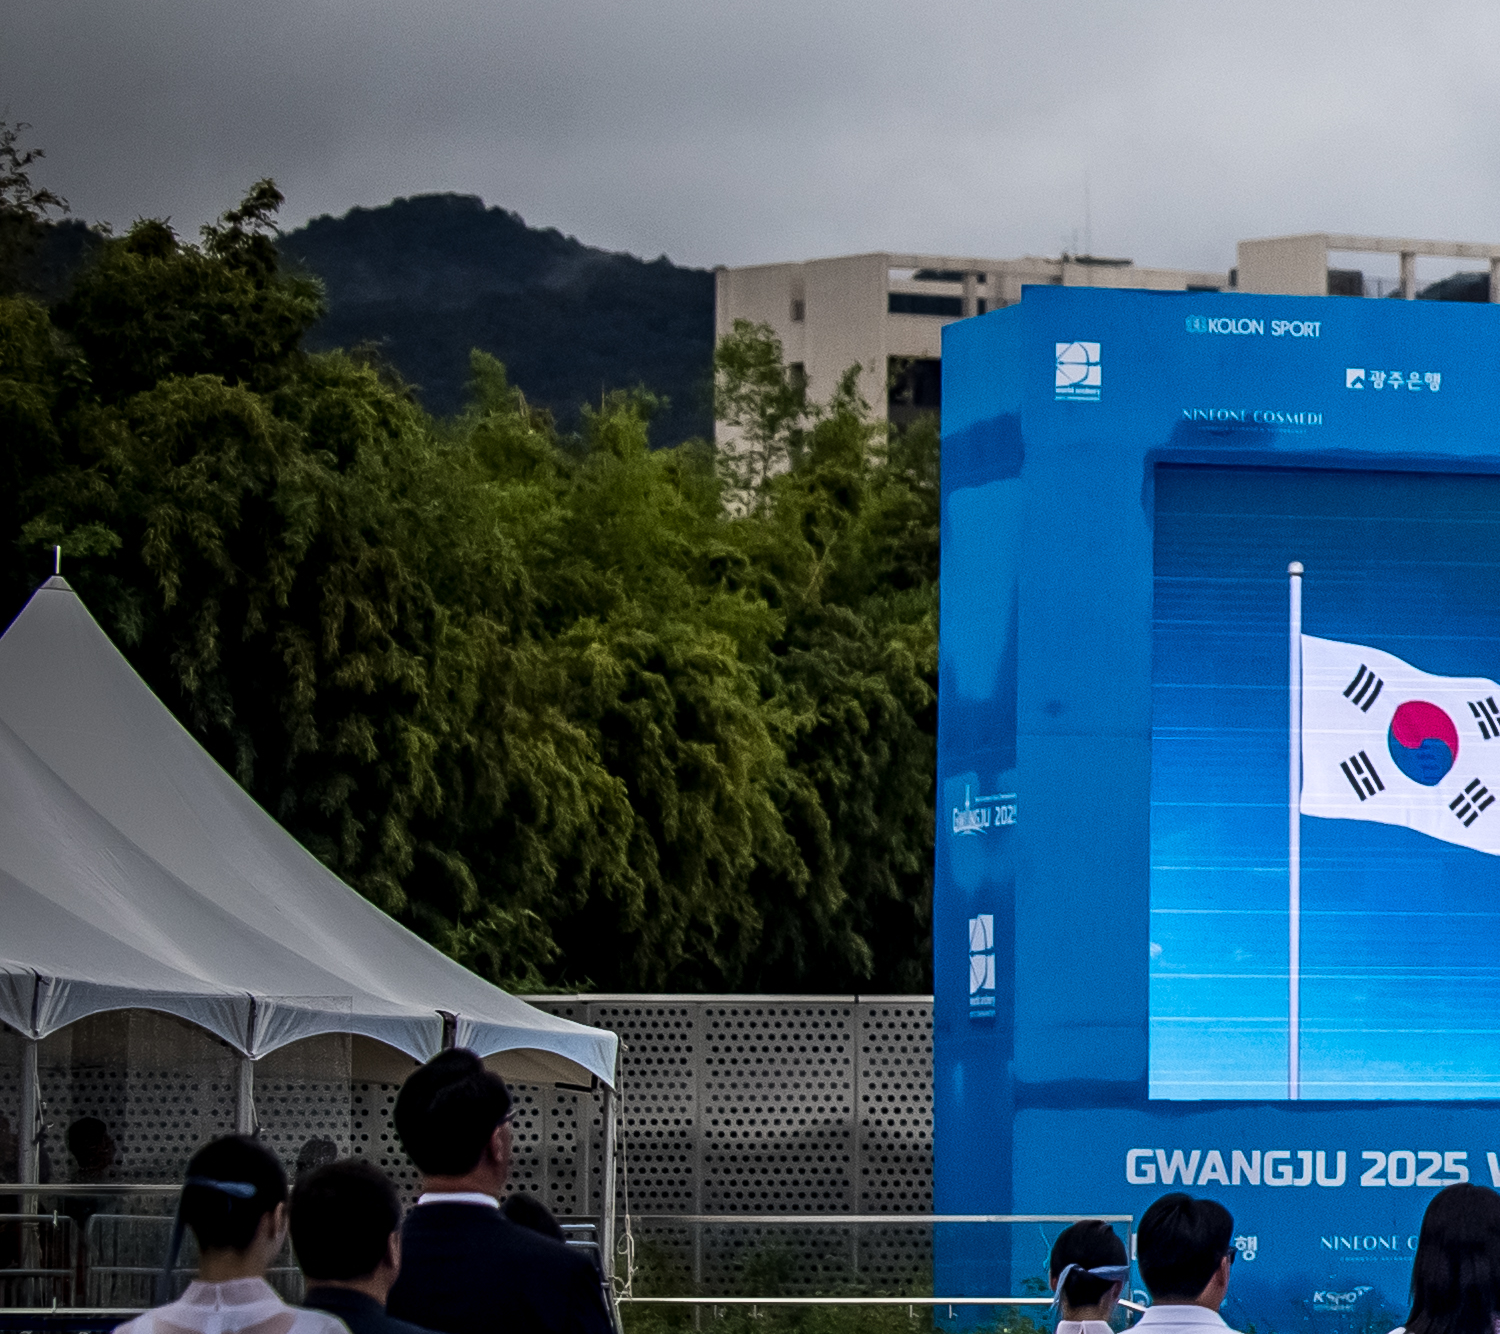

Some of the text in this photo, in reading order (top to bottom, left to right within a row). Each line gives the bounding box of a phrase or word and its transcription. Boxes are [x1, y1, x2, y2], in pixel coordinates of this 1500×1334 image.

[1208, 317, 1322, 337] KOLON SPORT
[1369, 369, 1443, 392] 광주은행
[1125, 1148, 1347, 1187] GWANGJU
[1359, 1150, 1470, 1188] 2025
[1319, 1234, 1398, 1251] NINEONE
